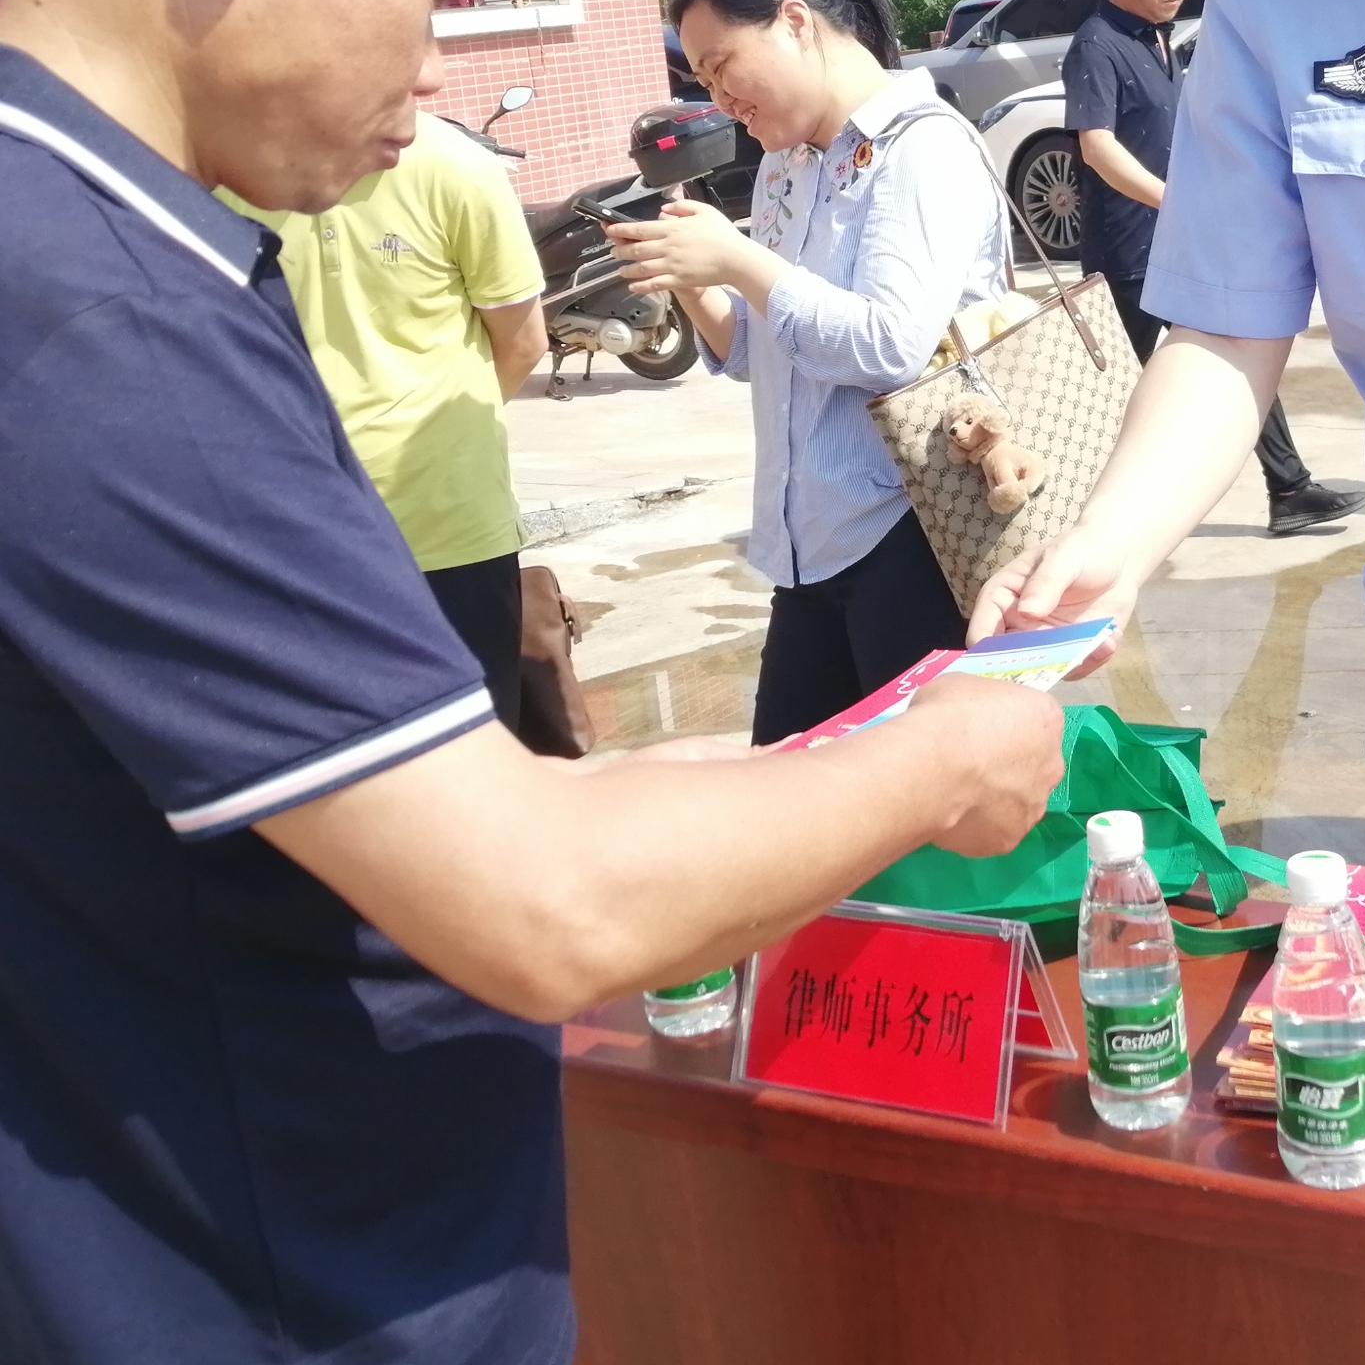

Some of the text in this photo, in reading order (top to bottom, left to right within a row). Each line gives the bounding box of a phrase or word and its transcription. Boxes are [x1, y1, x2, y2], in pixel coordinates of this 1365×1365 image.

[784, 967, 975, 1064] 律师事务所
